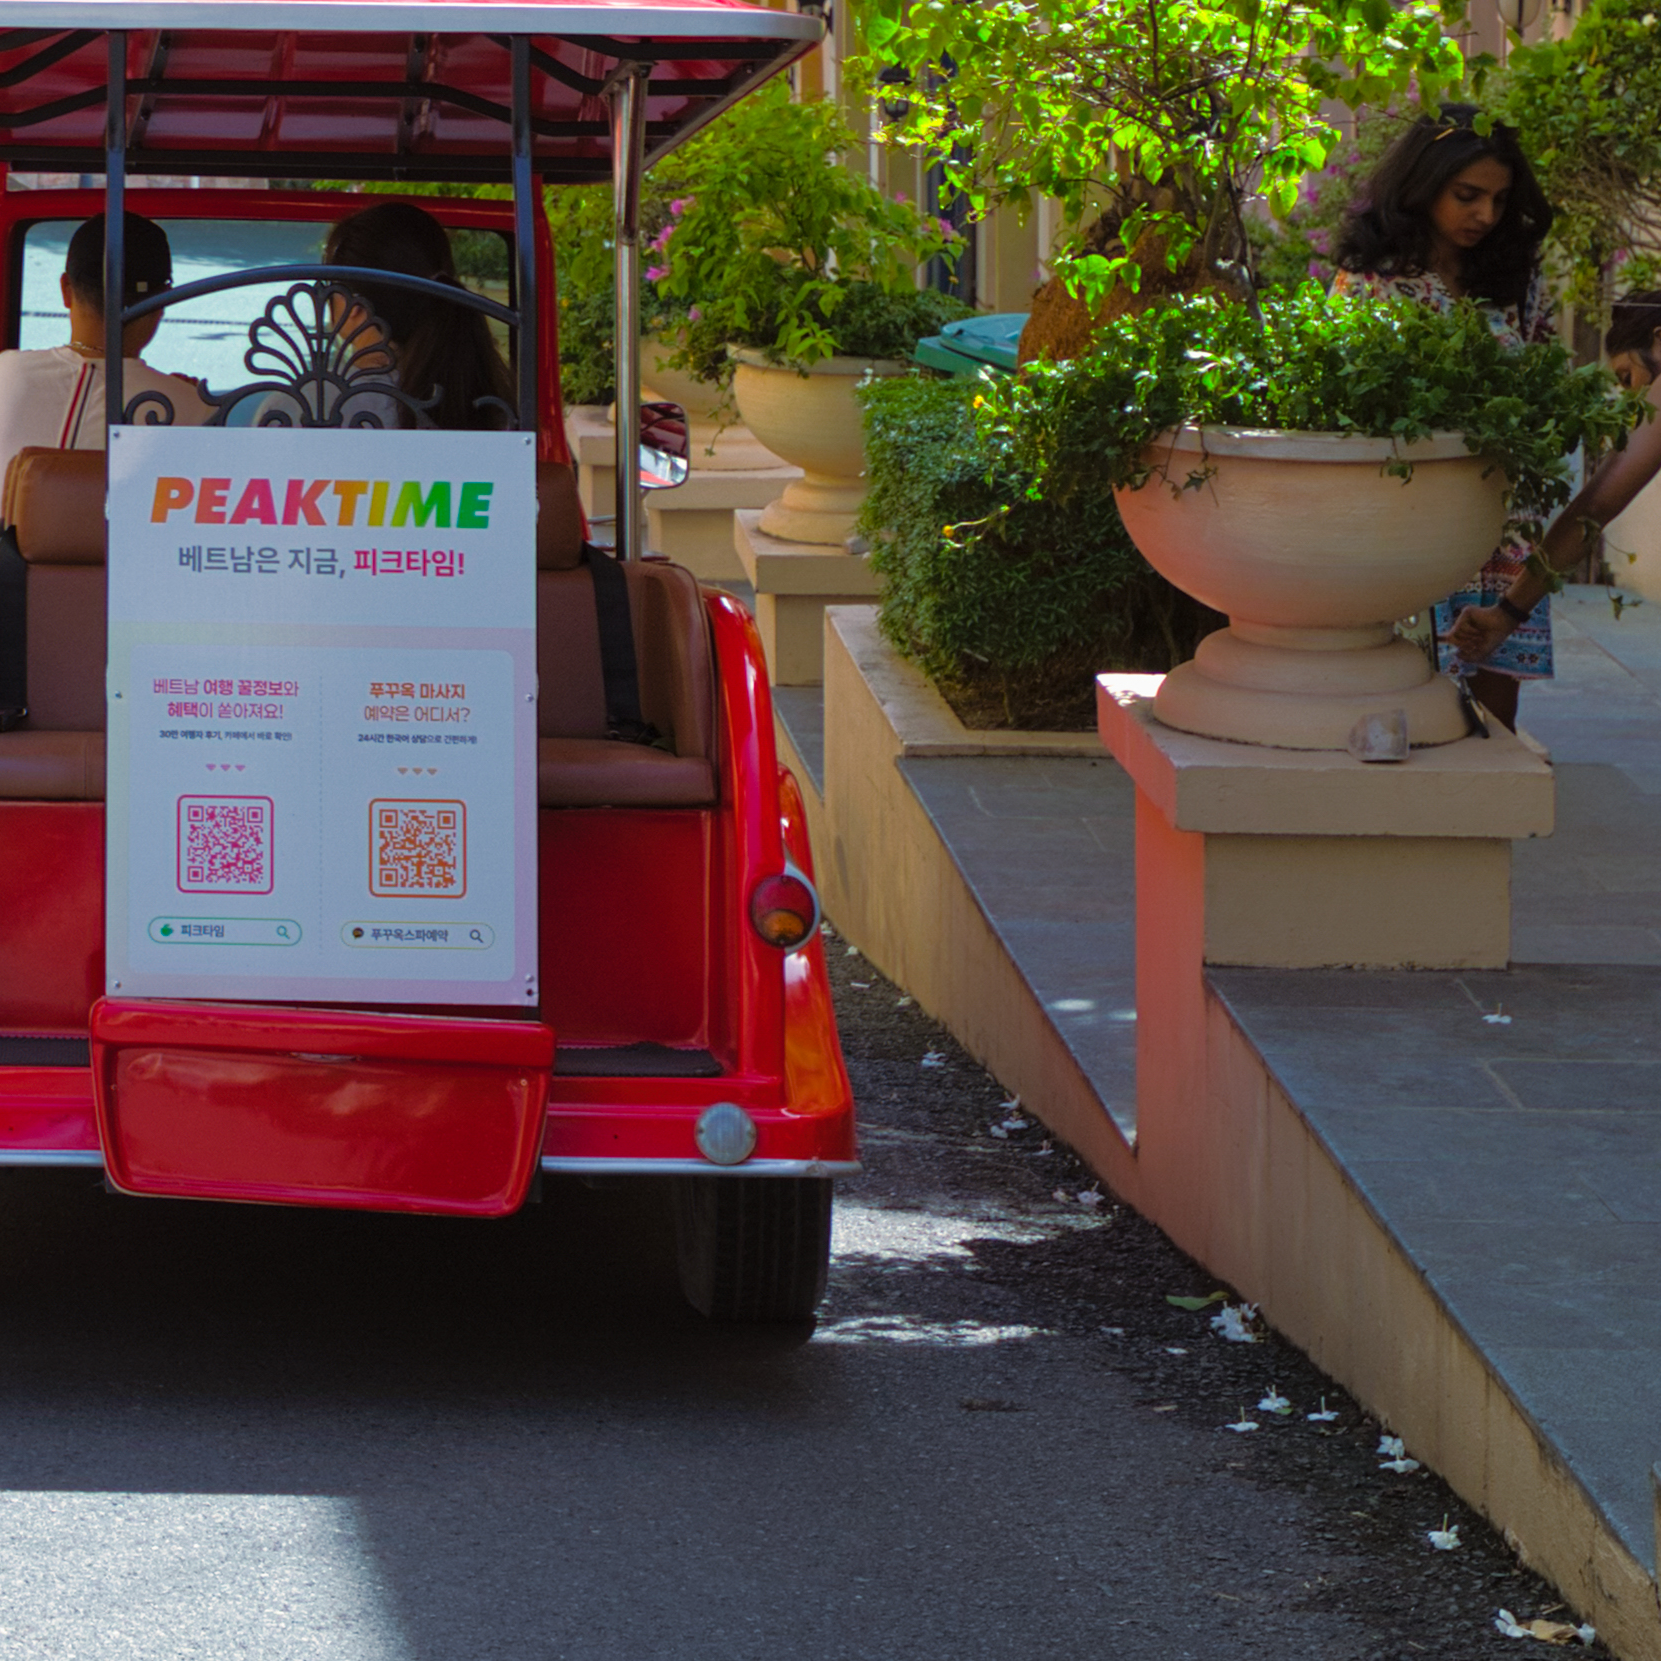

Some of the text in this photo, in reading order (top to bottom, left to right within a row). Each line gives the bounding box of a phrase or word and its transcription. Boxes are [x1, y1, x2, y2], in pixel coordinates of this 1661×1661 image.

[150, 477, 495, 529] PEAKTIME
[178, 545, 465, 579] 베트남은 지금, 피크타임!
[153, 678, 300, 697] 베트남 여행 꿀정보와
[369, 682, 466, 700] 푸꾸옥 마사지
[167, 701, 284, 720] 혜택이 쏟아져요!
[364, 705, 471, 723] 예약은 어디서?
[180, 924, 225, 938] 피크타임
[370, 928, 449, 943] 푸꾸옥스파예약
